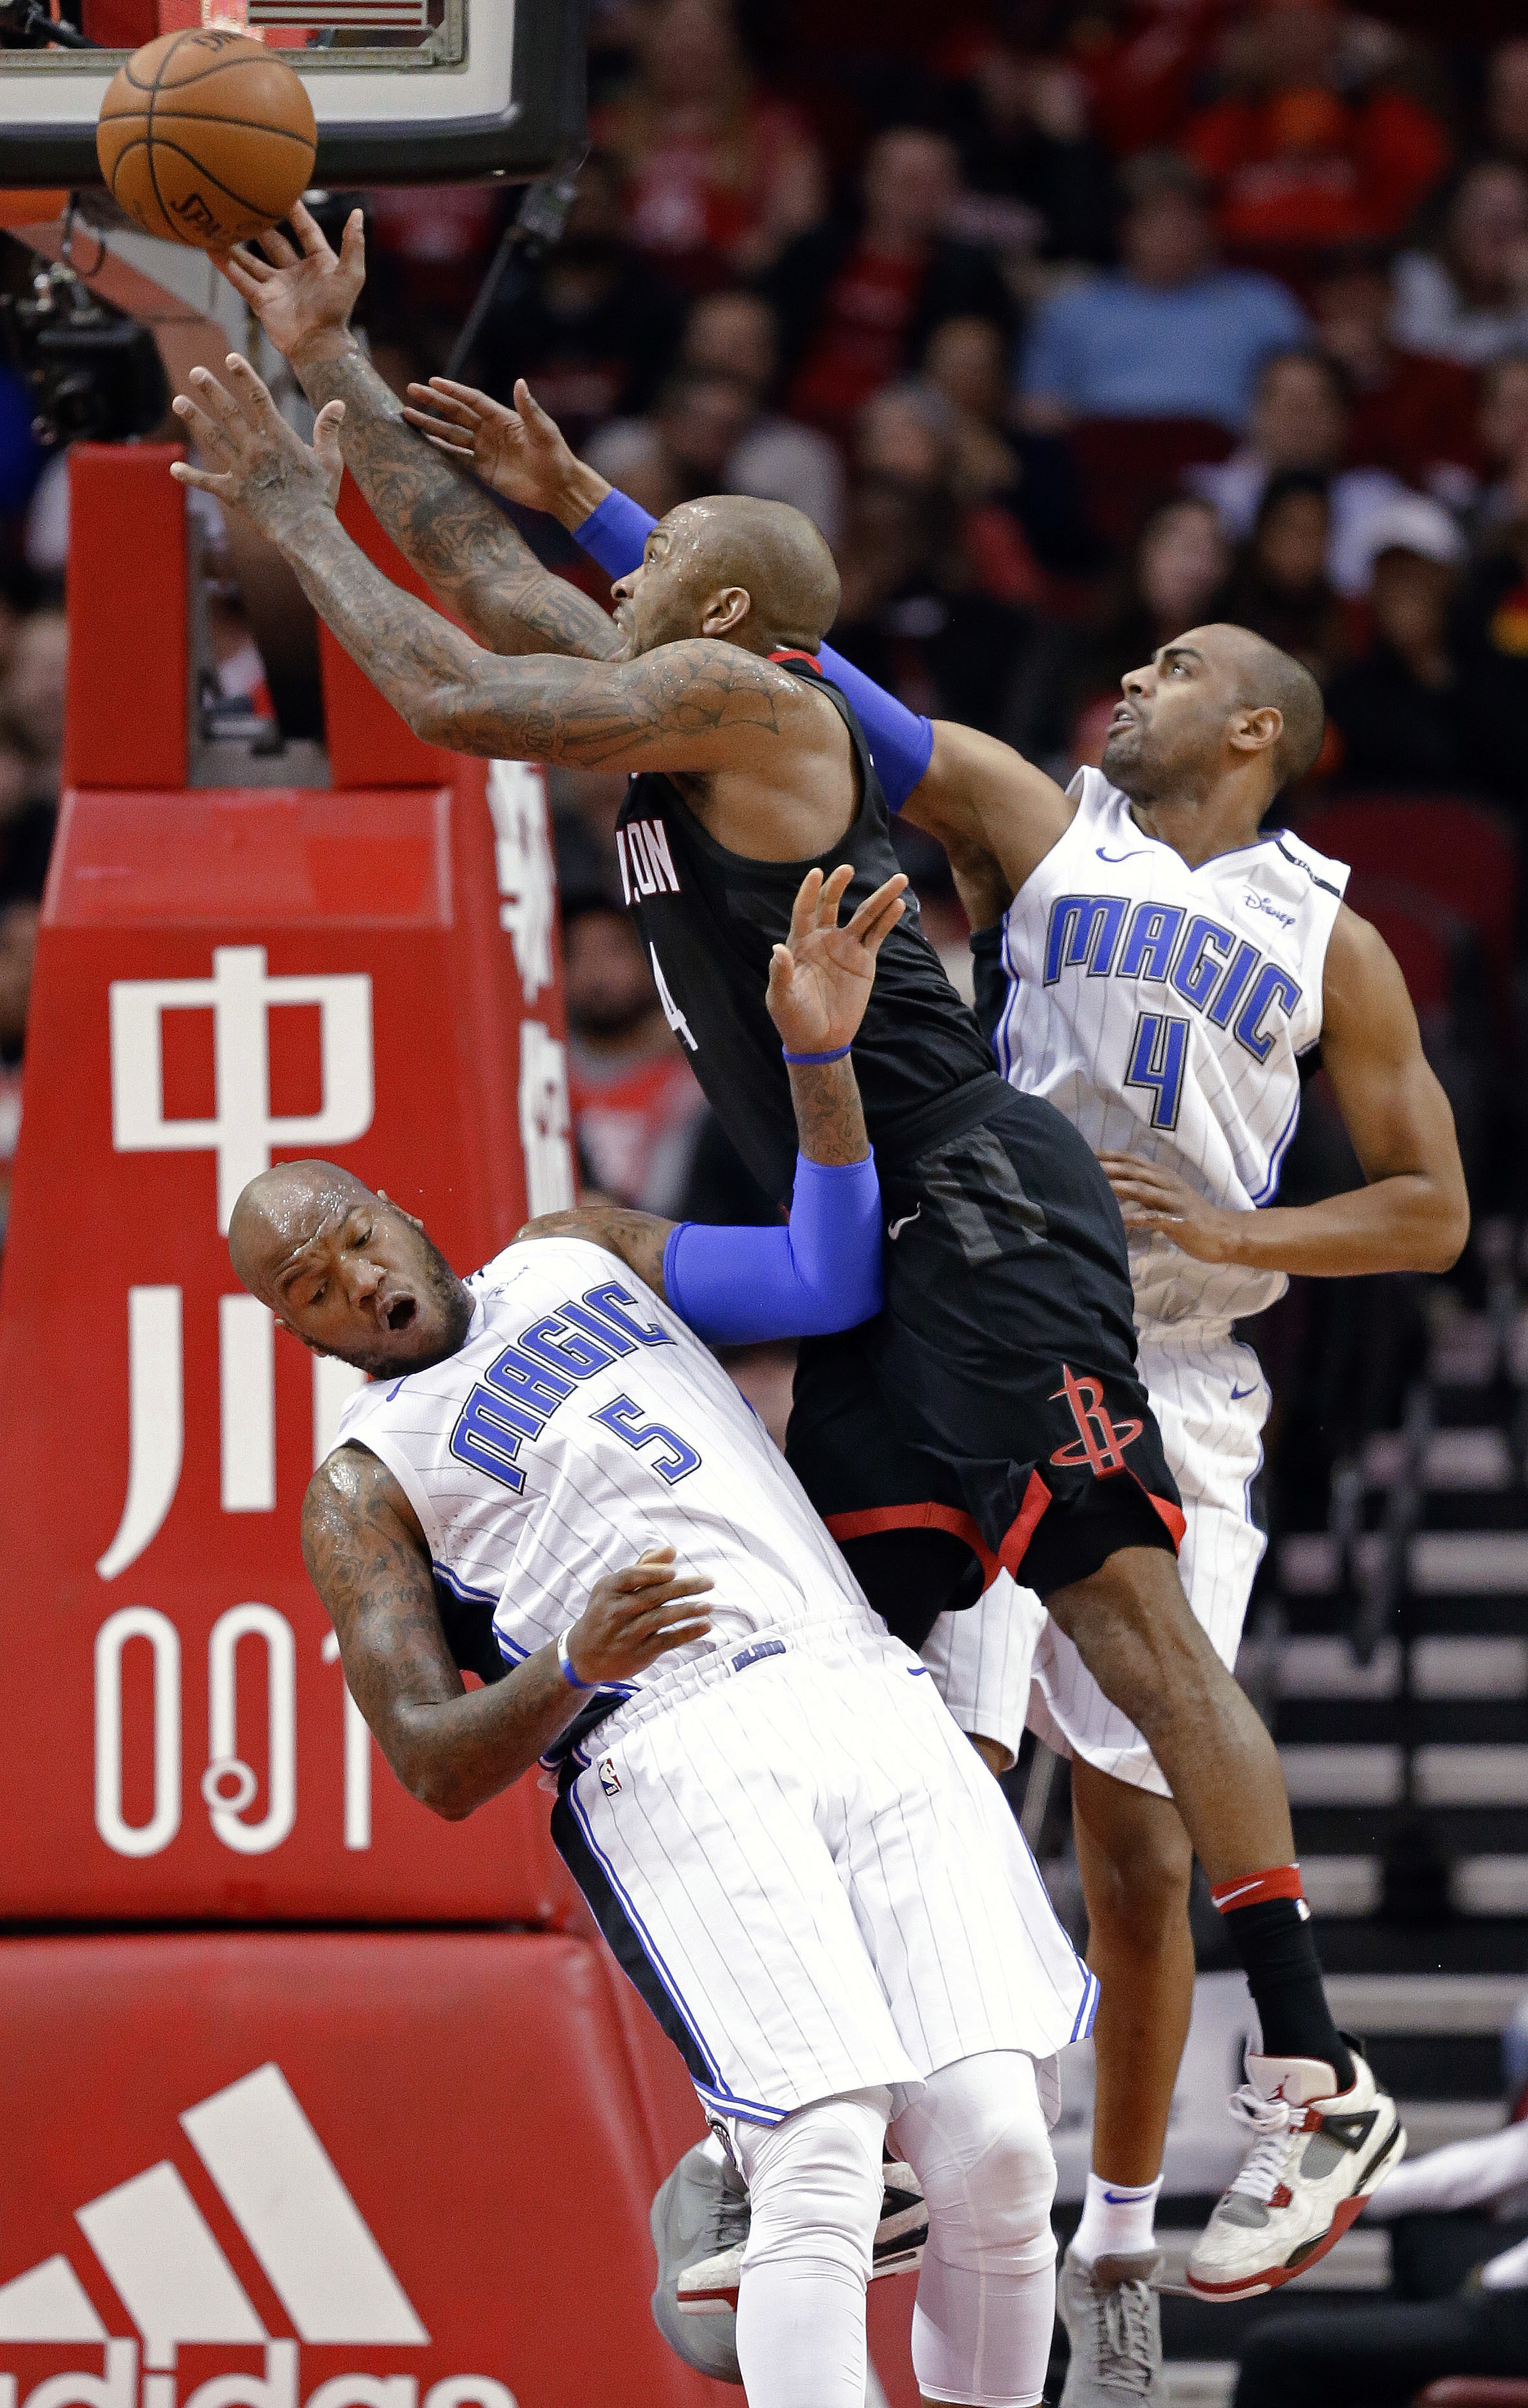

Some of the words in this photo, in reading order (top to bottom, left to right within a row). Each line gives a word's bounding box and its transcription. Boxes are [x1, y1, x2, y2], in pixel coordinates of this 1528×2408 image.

[1043, 894, 1302, 1064] MAGIC
[1124, 1012, 1191, 1132] 4
[449, 1280, 676, 1496] MAGIC
[590, 1393, 702, 1486] 5
